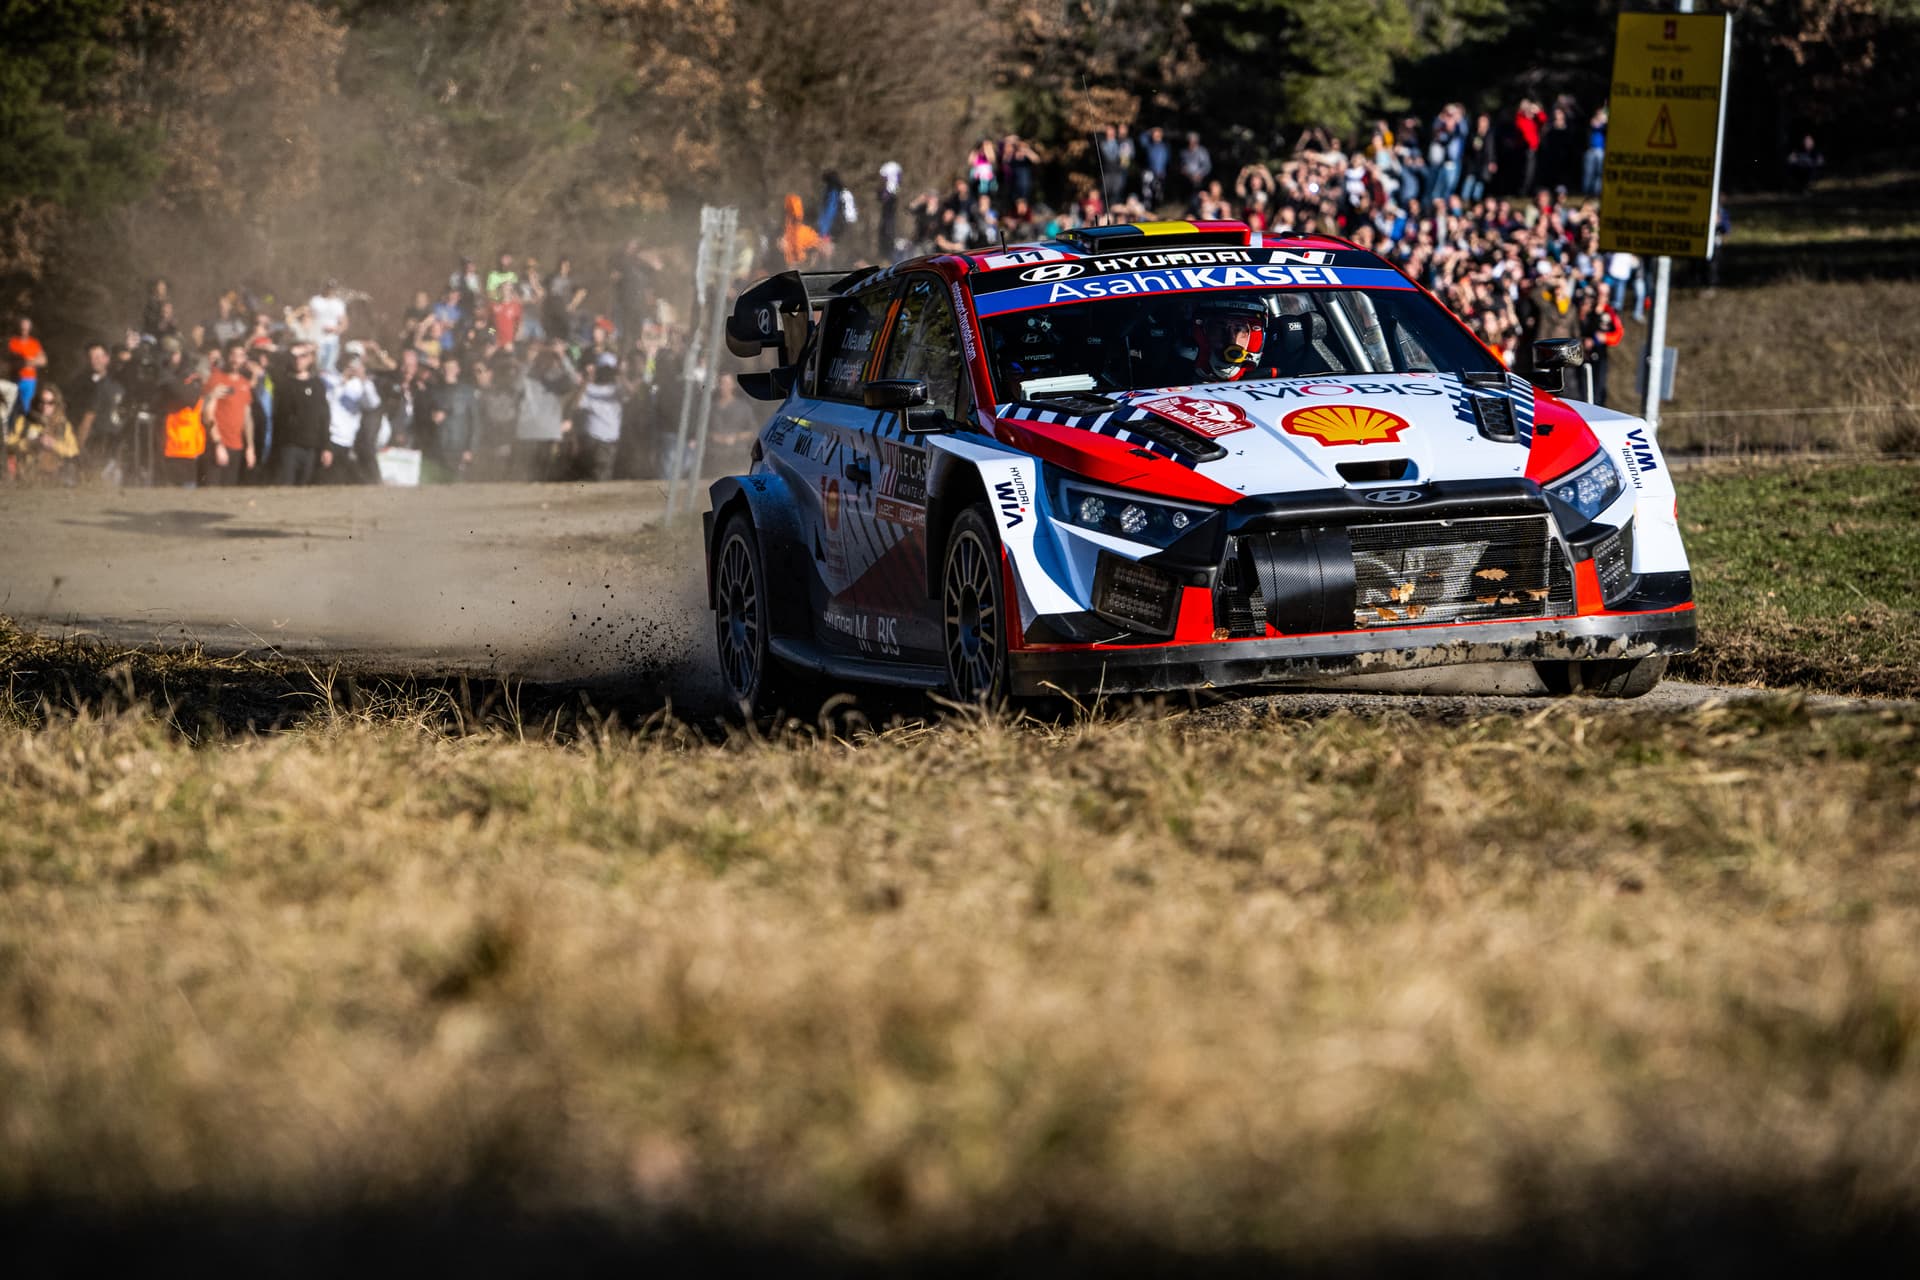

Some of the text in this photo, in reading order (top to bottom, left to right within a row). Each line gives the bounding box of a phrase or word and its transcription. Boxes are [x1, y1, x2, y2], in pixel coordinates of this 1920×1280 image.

[1006, 251, 1045, 264] 11
[1094, 251, 1252, 272] HYUNDAI
[1205, 378, 1342, 393] HYUNDAI
[1244, 382, 1443, 401] MOBIS
[1621, 448, 1643, 489] HYUNDAI
[1009, 466, 1030, 505] HYUNDAI
